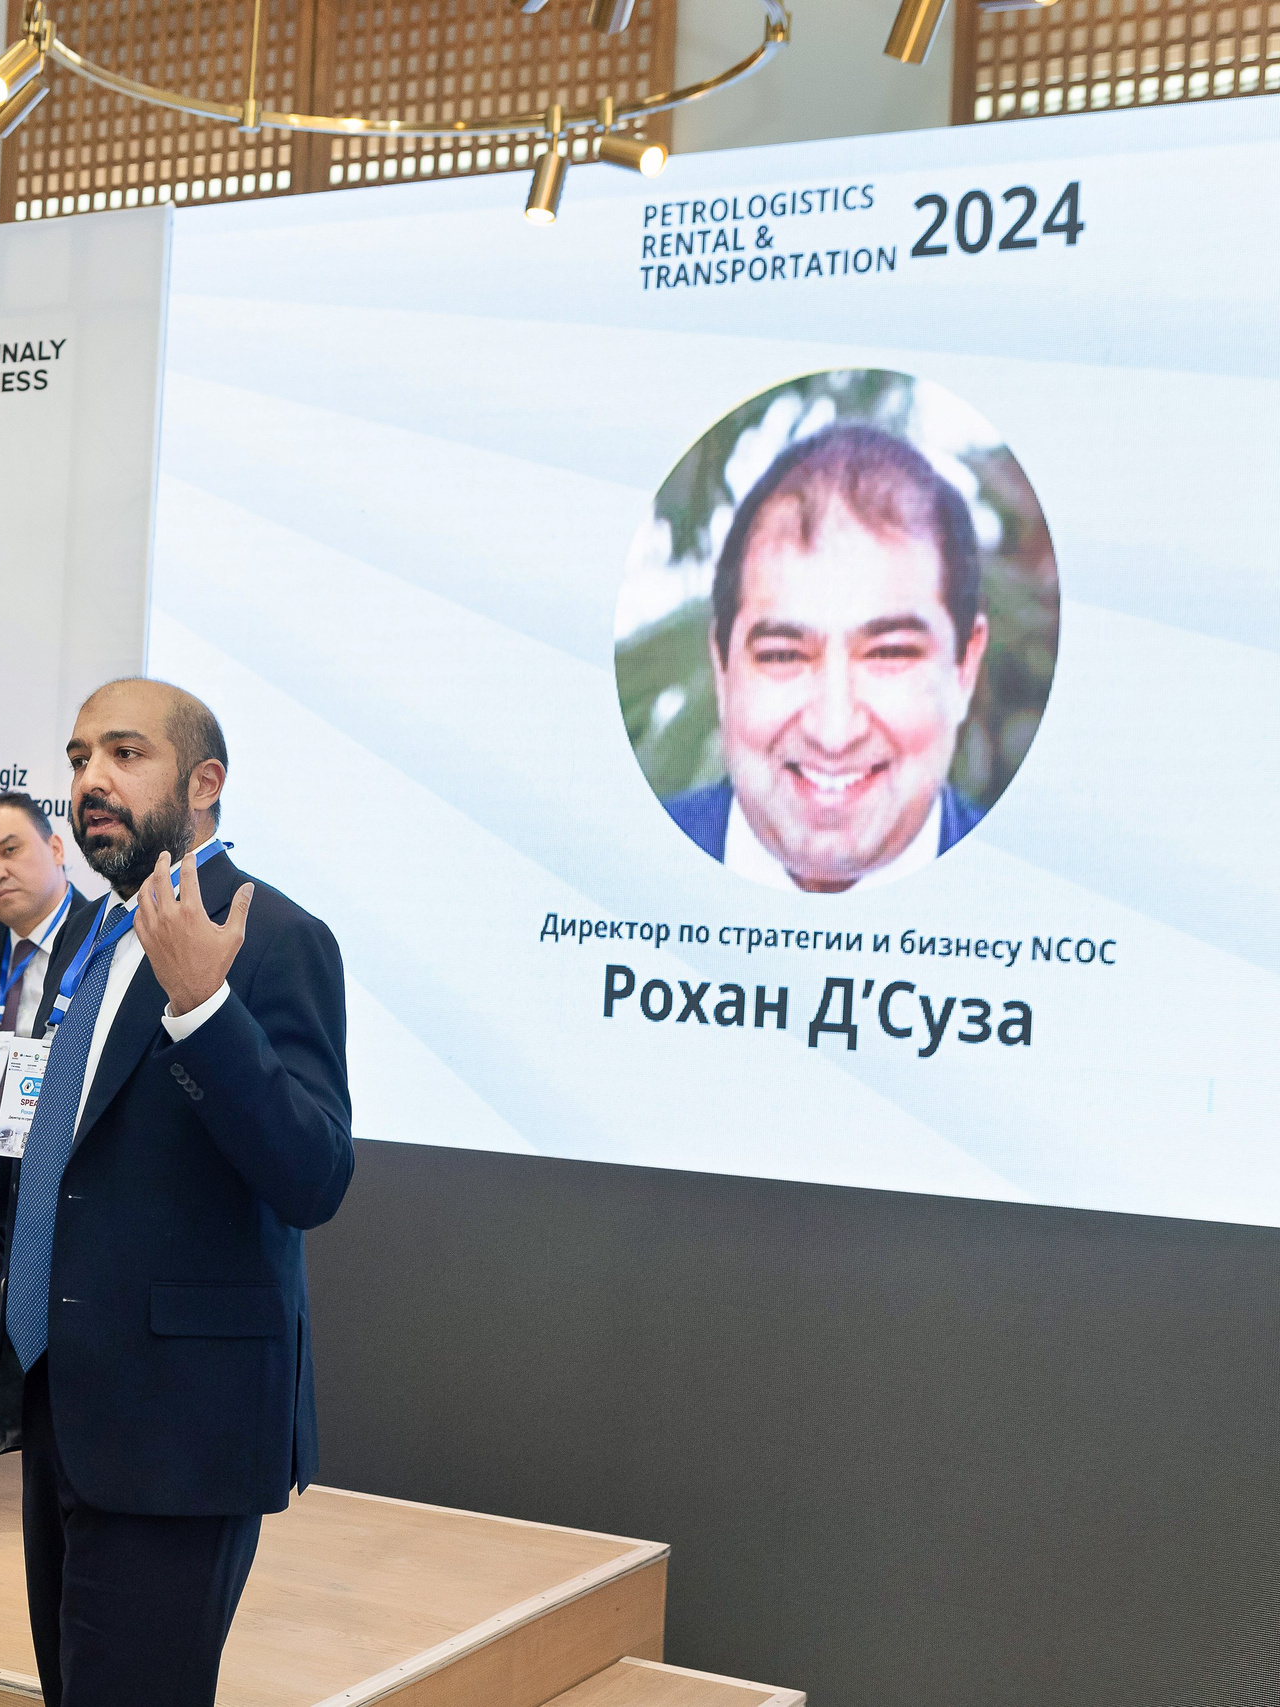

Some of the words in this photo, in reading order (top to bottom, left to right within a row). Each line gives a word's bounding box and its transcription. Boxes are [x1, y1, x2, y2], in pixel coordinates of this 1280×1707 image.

[643, 184, 876, 228] PETROLOGISTICS
[911, 180, 1086, 259] 2024
[641, 226, 746, 259] RENTAL
[754, 225, 775, 249] &
[639, 246, 898, 291] TRANSPORTATION
[539, 911, 671, 949] Директор
[678, 923, 711, 944] по
[719, 925, 864, 954] стратегии
[872, 933, 891, 954] и
[899, 928, 1023, 968] бизнесу
[1031, 936, 1118, 965] NCOC
[603, 963, 789, 1030] Рохан
